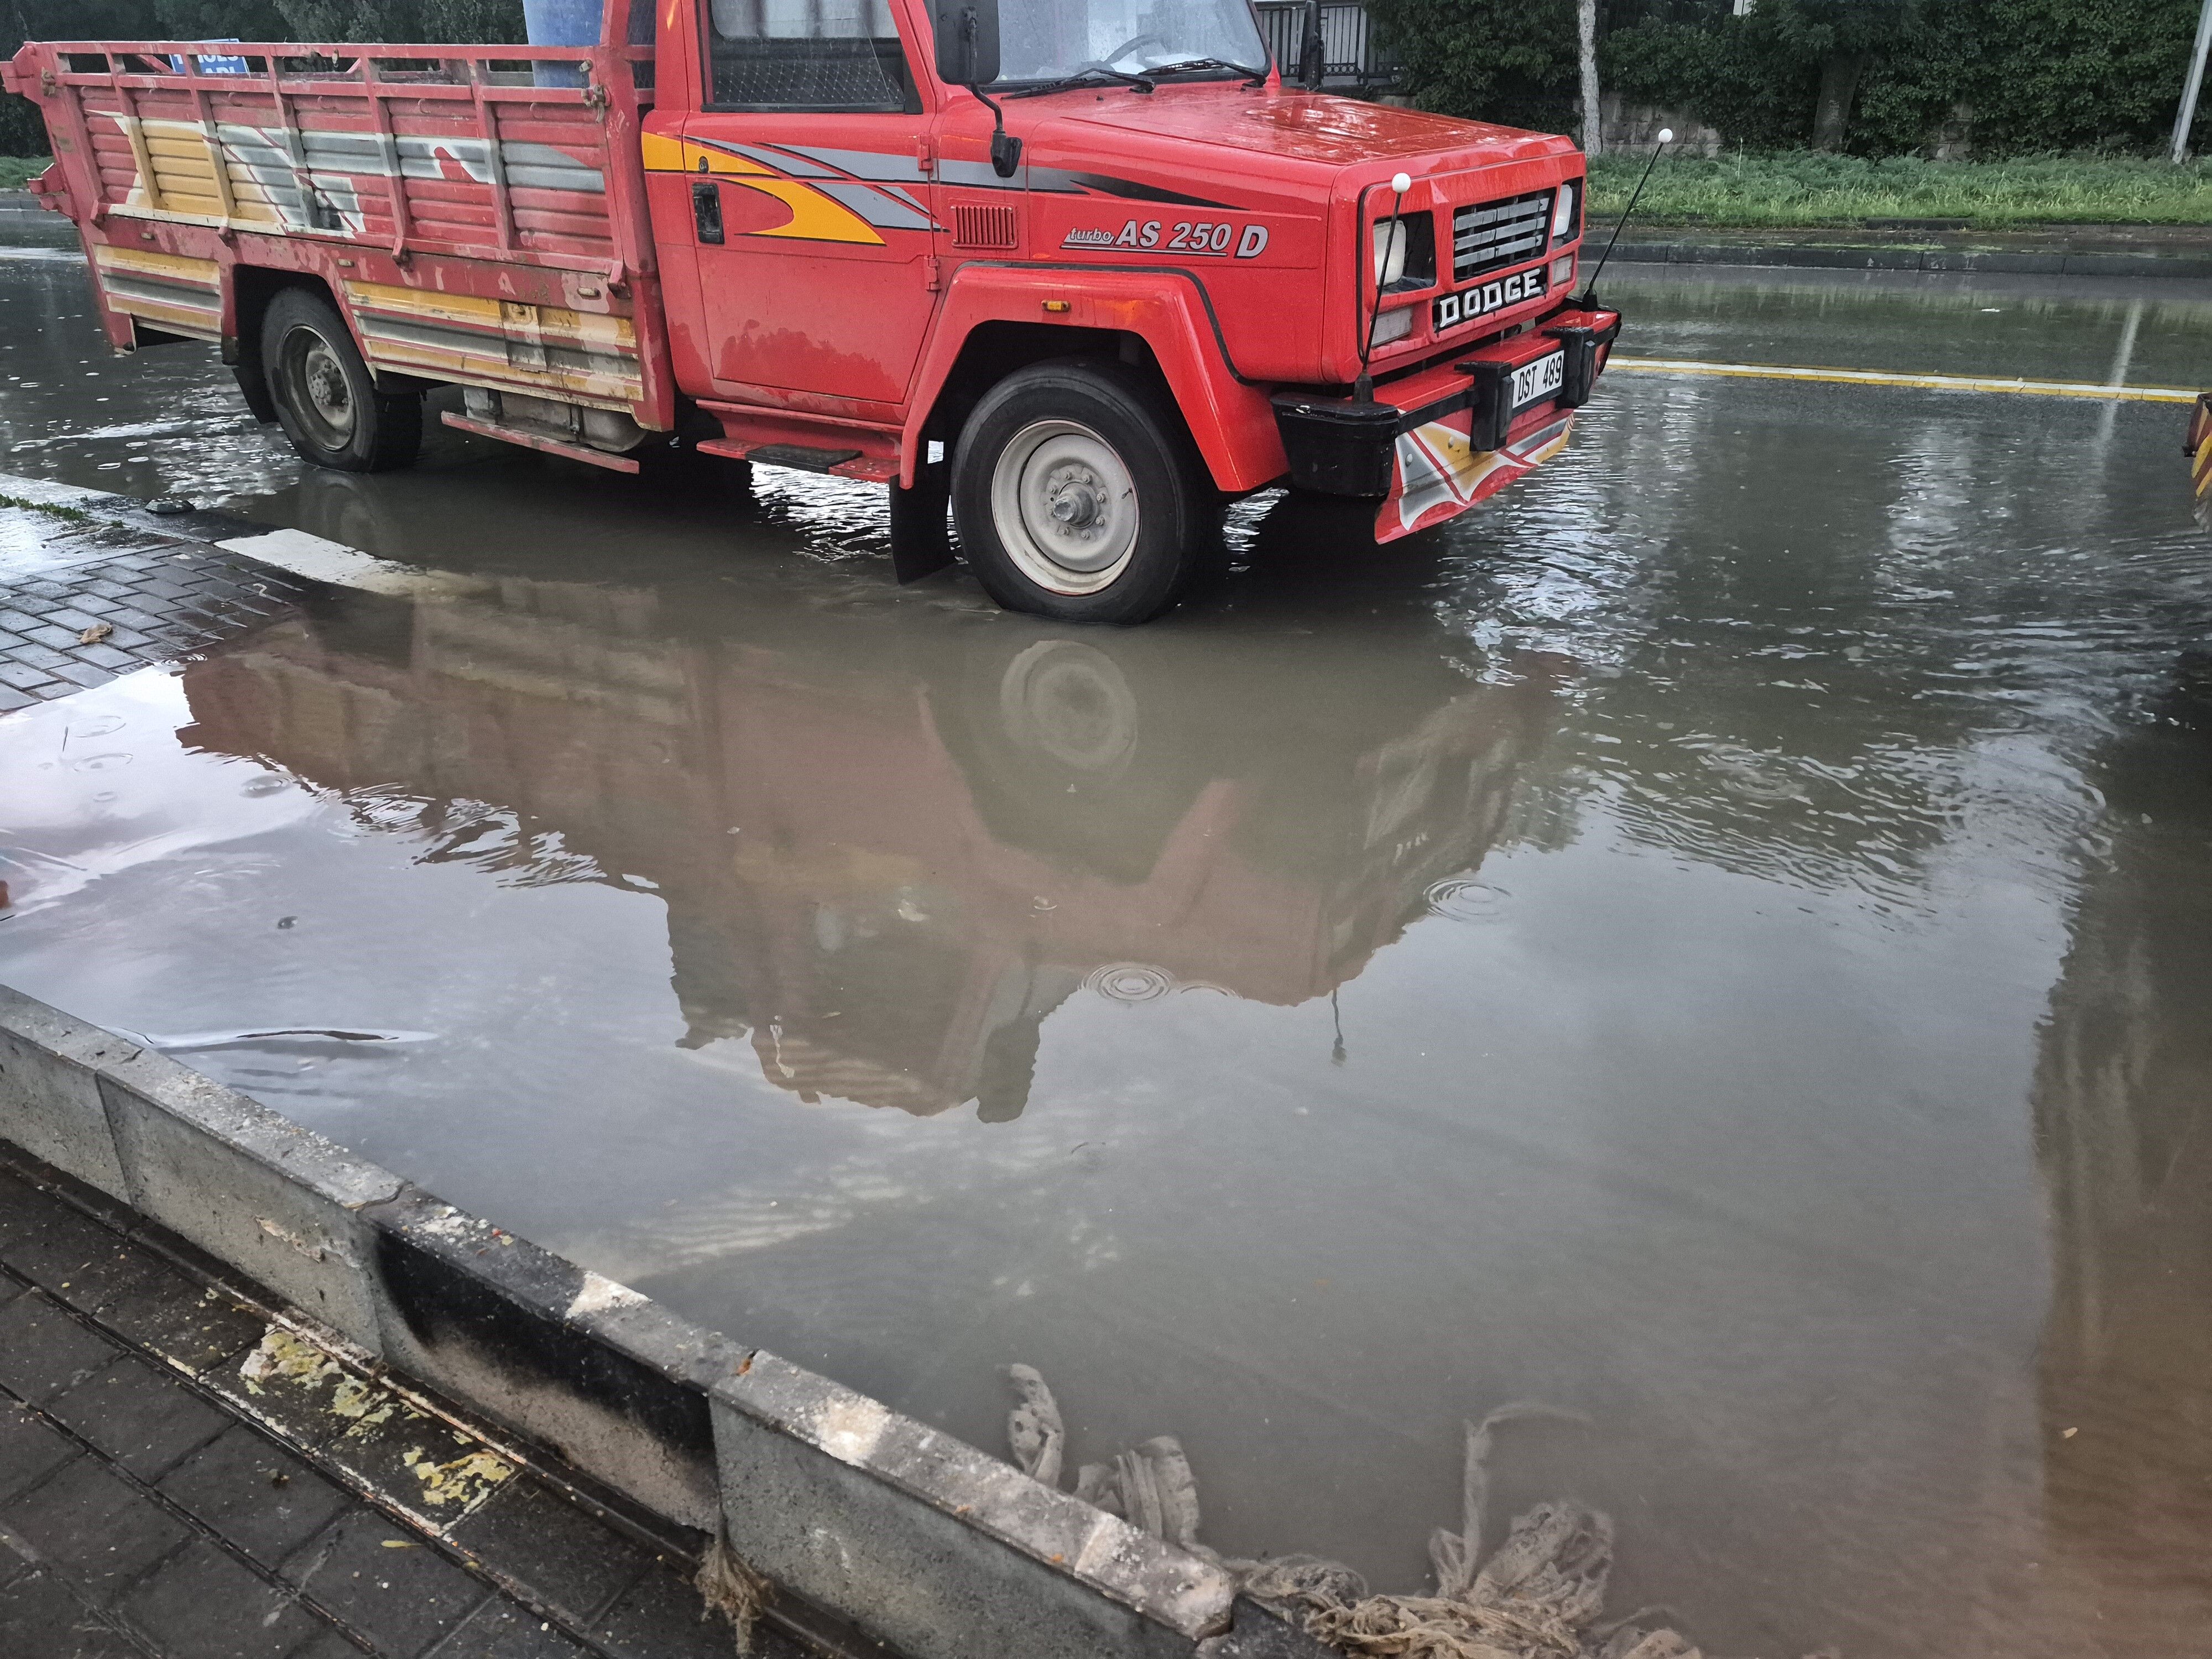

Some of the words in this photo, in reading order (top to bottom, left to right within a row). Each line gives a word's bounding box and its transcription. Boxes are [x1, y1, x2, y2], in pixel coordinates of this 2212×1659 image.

[1070, 227, 1112, 242] turbo
[1114, 220, 1161, 248] AS
[1167, 222, 1233, 252] 250
[1234, 224, 1269, 259] D
[1439, 268, 1541, 328] DODGE
[1517, 365, 1537, 403] DST
[1543, 354, 1562, 389] 489
